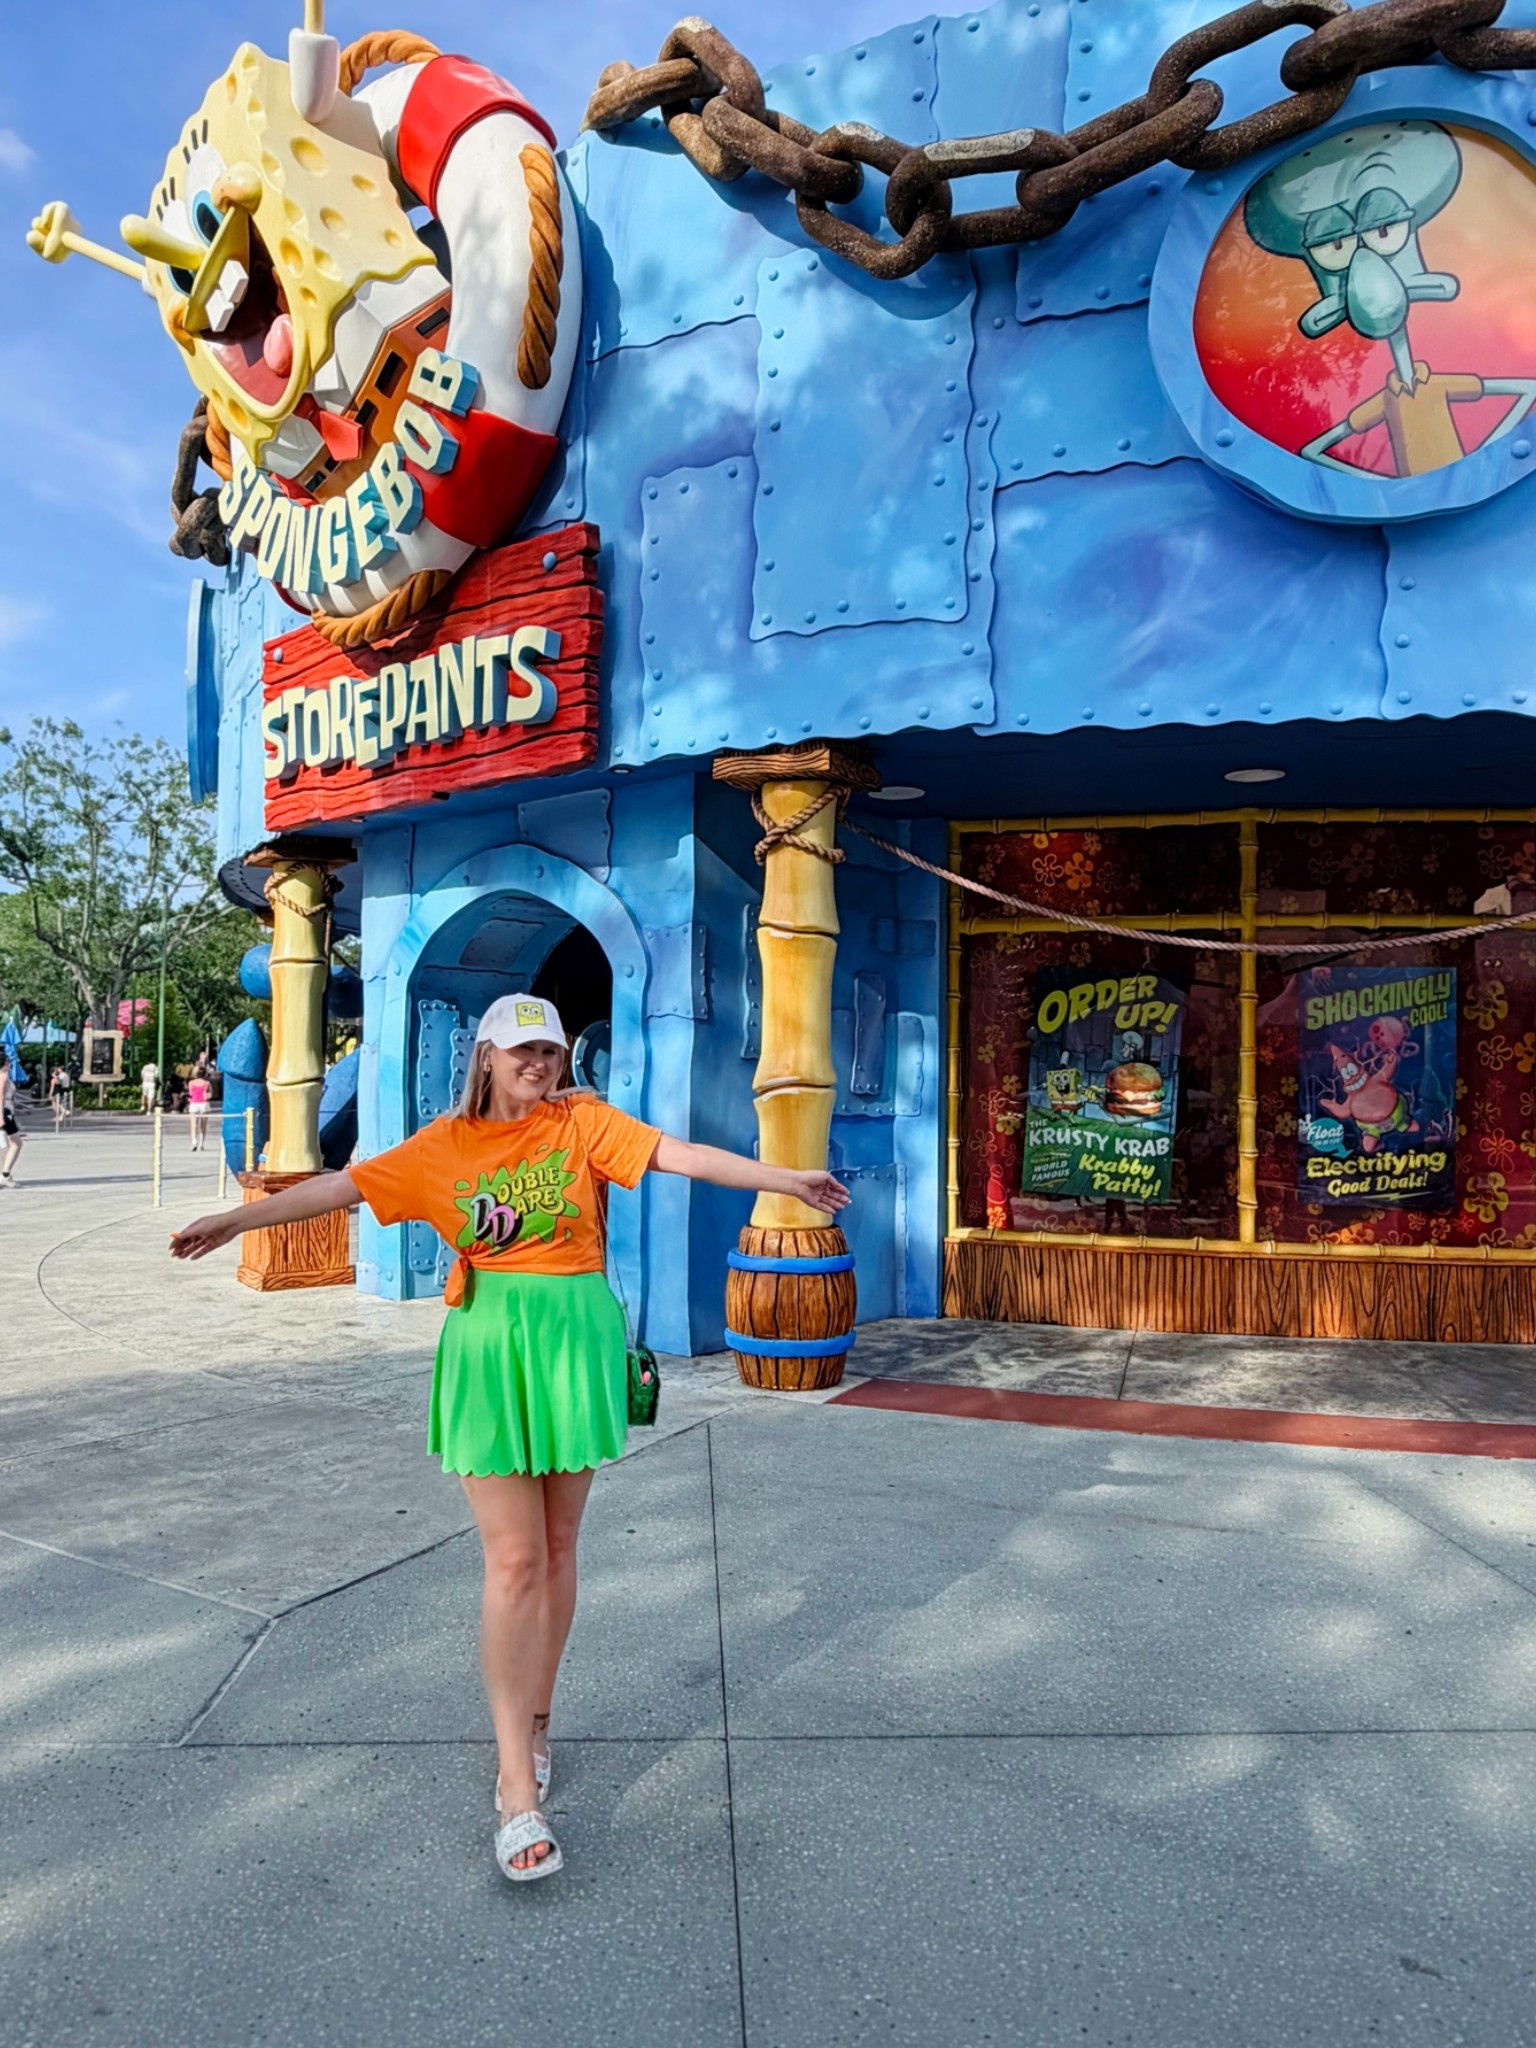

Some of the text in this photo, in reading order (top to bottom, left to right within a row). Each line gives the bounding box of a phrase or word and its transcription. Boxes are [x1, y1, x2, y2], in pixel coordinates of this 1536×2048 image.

[218, 347, 476, 594] SPONGEBOB
[261, 625, 560, 780] STOREPANTS
[1037, 975, 1159, 1034] ORDER
[1306, 972, 1451, 1031] SHOCKINGLY
[1409, 1002, 1448, 1028] COOL!
[1114, 1001, 1179, 1033] UP!
[1029, 1118, 1049, 1129] THE
[1306, 1123, 1345, 1141] Float
[1029, 1127, 1170, 1157] KRUSTY KRAB
[1031, 1168, 1071, 1182] FAMOUS
[1033, 1160, 1068, 1173] WORLD
[1078, 1153, 1156, 1180] Krabby
[1306, 1149, 1447, 1178] Electrifying
[1092, 1172, 1162, 1199] Patty!
[1327, 1172, 1429, 1197] Good Deals!
[470, 1166, 560, 1241] DOUBLE
[487, 1188, 566, 1246] DARE
